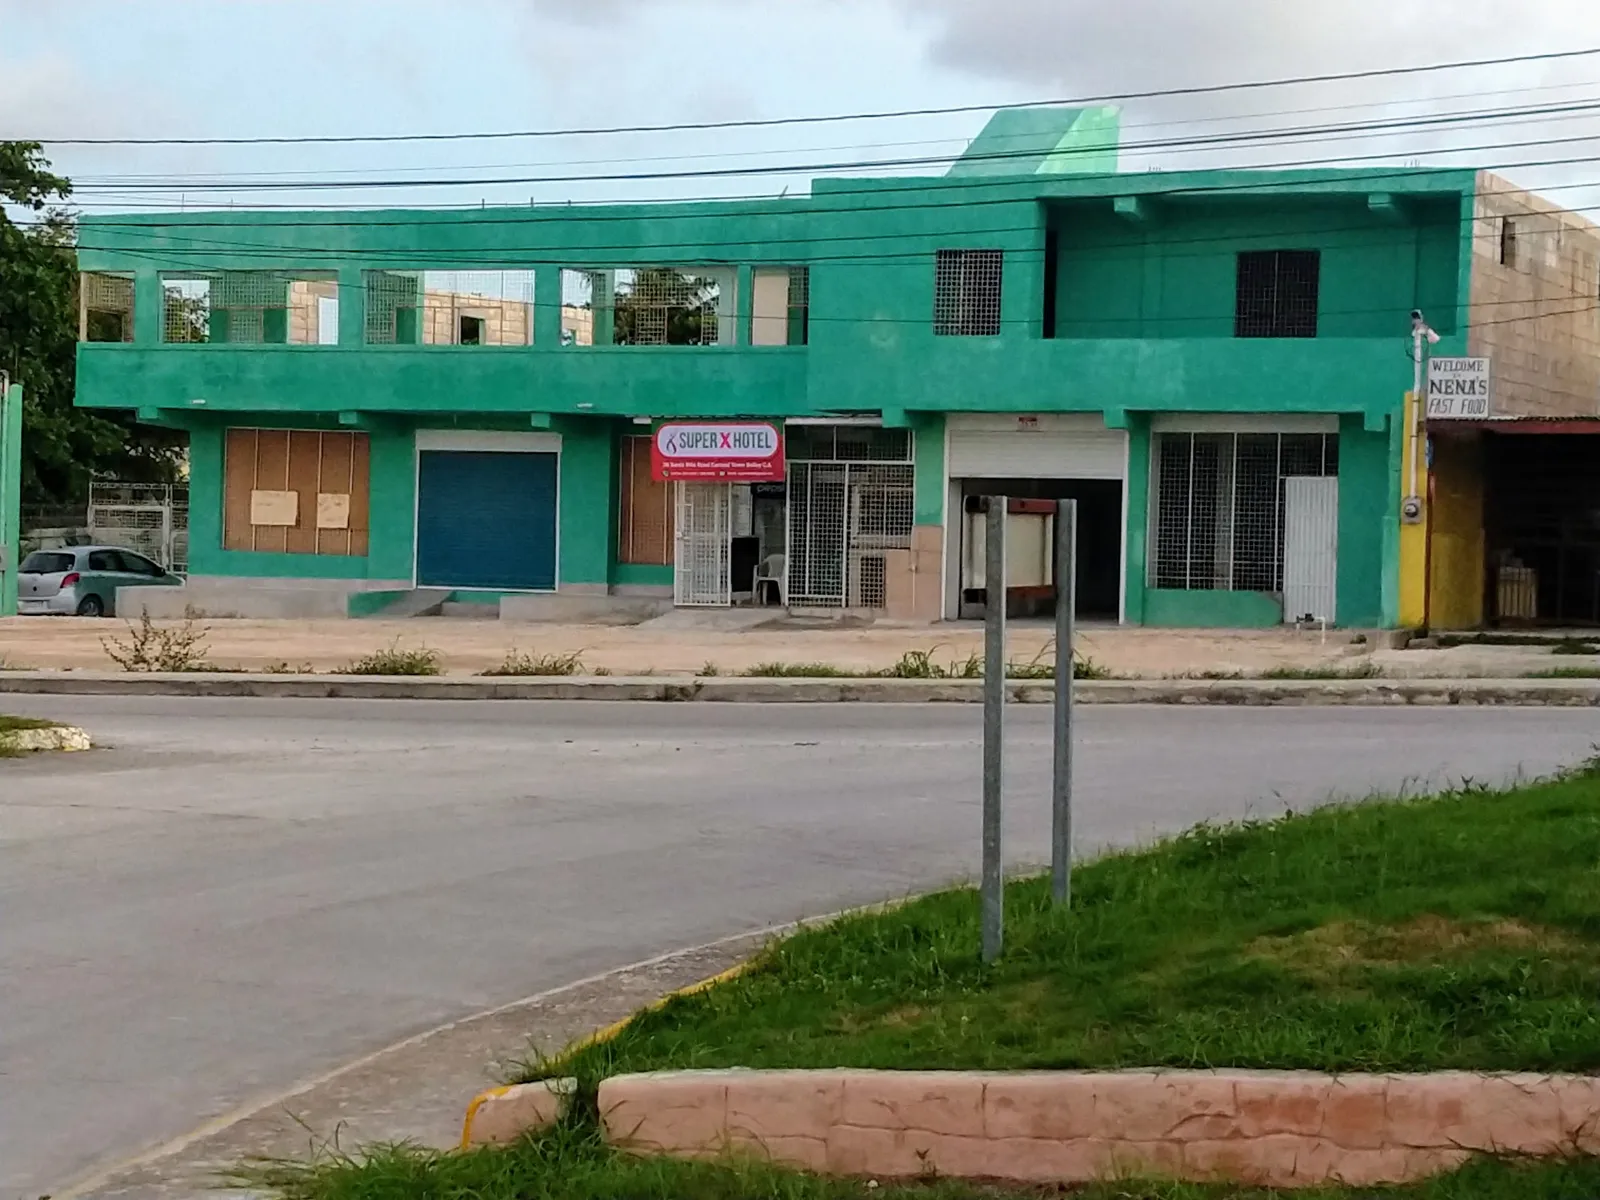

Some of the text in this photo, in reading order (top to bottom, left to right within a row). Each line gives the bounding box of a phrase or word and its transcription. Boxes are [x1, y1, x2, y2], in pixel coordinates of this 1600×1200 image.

[1432, 360, 1484, 372] WELCOME
[1429, 376, 1487, 395] NENA'S
[1429, 398, 1486, 414] FAST FOOD
[679, 432, 772, 449] SUPER X HOTEL
